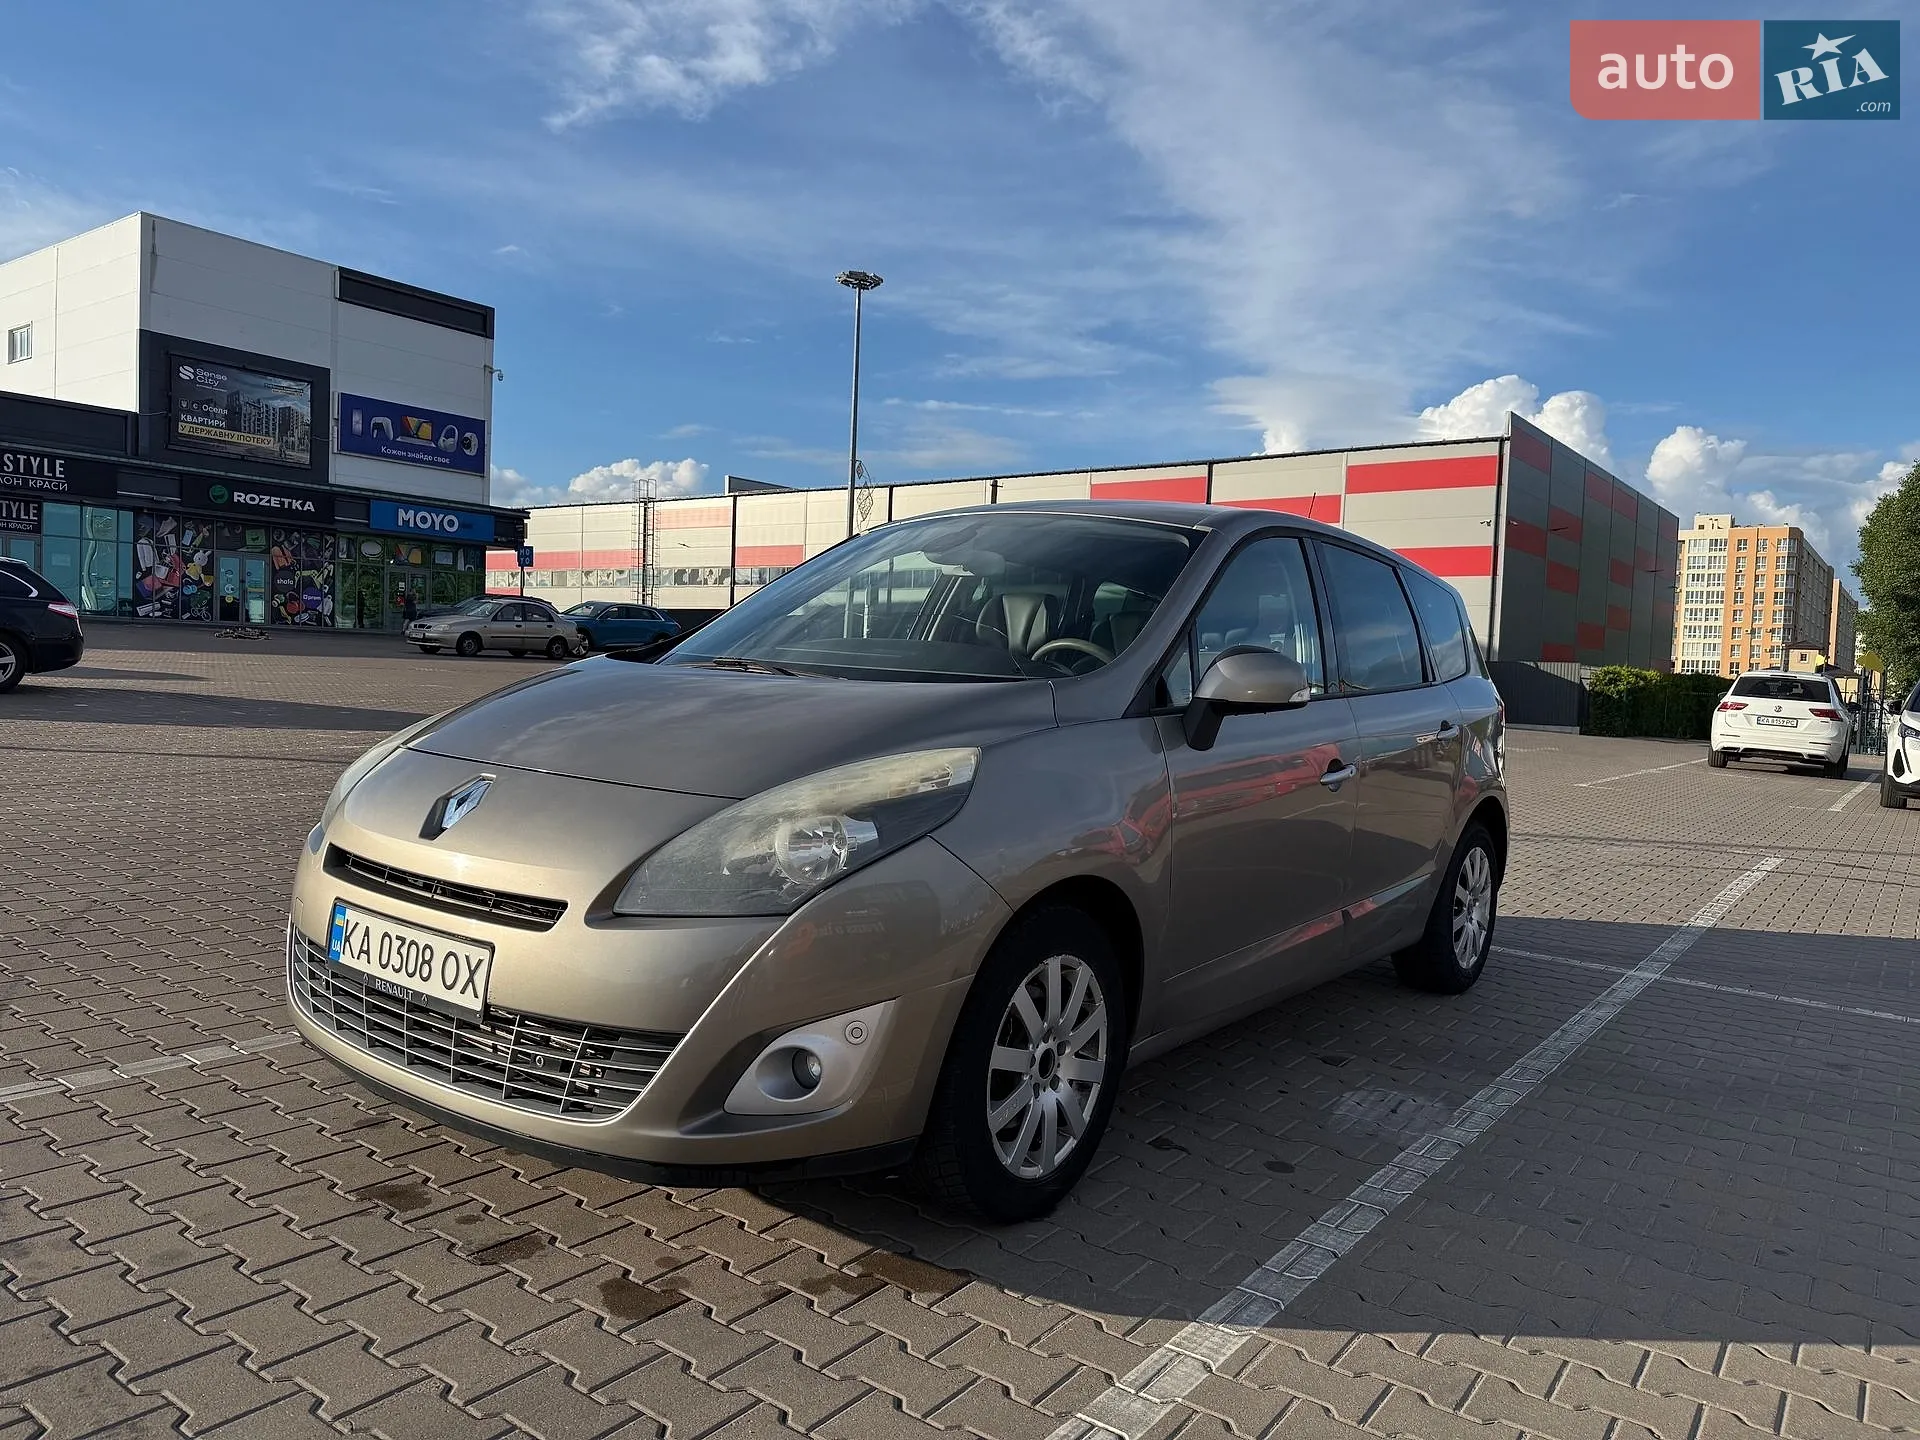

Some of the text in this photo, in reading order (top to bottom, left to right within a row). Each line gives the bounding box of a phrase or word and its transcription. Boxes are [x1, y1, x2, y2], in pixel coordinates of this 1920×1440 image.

[196, 375, 220, 387] City
[202, 404, 228, 415] Оселя
[181, 413, 226, 428] КВАРТИРИ
[188, 425, 235, 441] ДЕРЖАВНУ
[236, 434, 272, 446] ІПОТЕКУ
[3, 453, 65, 478] STYLE
[29, 479, 68, 491] КРАСИ
[233, 491, 315, 512] ROZETKA
[8, 522, 33, 531] КРАСИ
[398, 508, 459, 532] MOYO
[331, 939, 341, 952] UA
[342, 918, 485, 999] KA 0308 OX
[375, 978, 414, 1001] RENAULT
